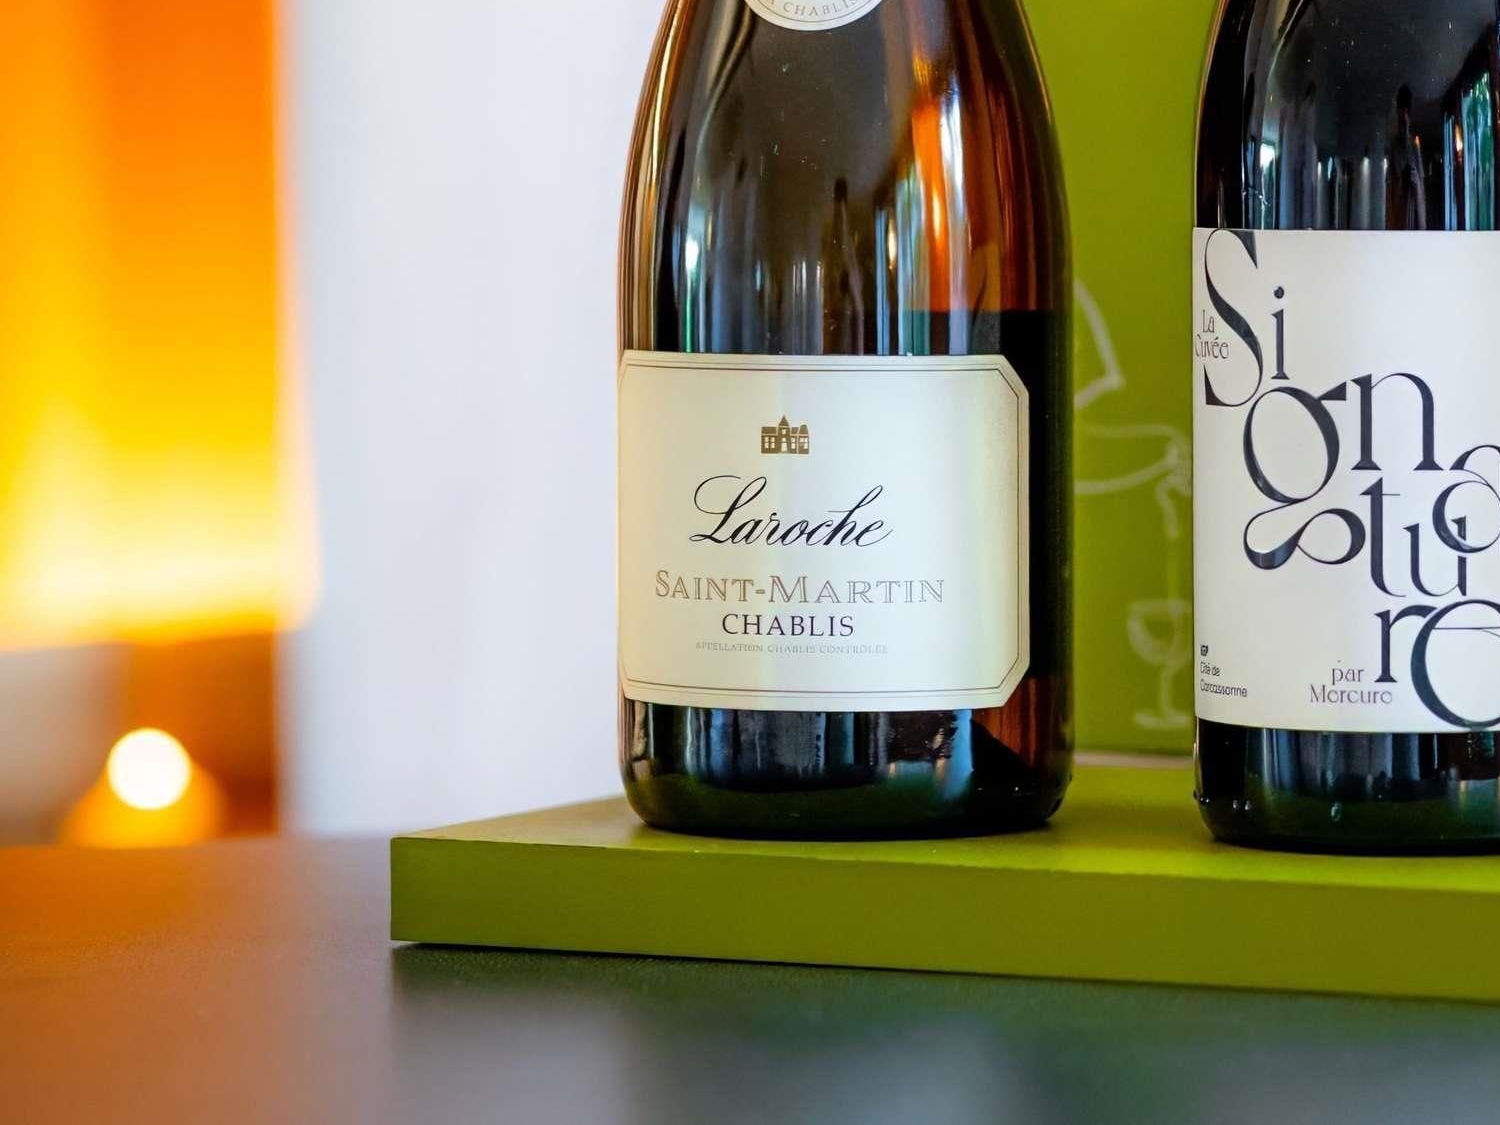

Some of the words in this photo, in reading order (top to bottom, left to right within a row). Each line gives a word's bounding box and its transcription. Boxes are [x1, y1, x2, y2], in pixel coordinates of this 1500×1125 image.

[1202, 309, 1215, 333] La
[689, 475, 893, 547] Laroche
[655, 570, 944, 604] SAINT-MARTIN
[722, 613, 855, 638] CHABLIS
[1331, 667, 1365, 686] par
[1310, 683, 1393, 705] Mercure
